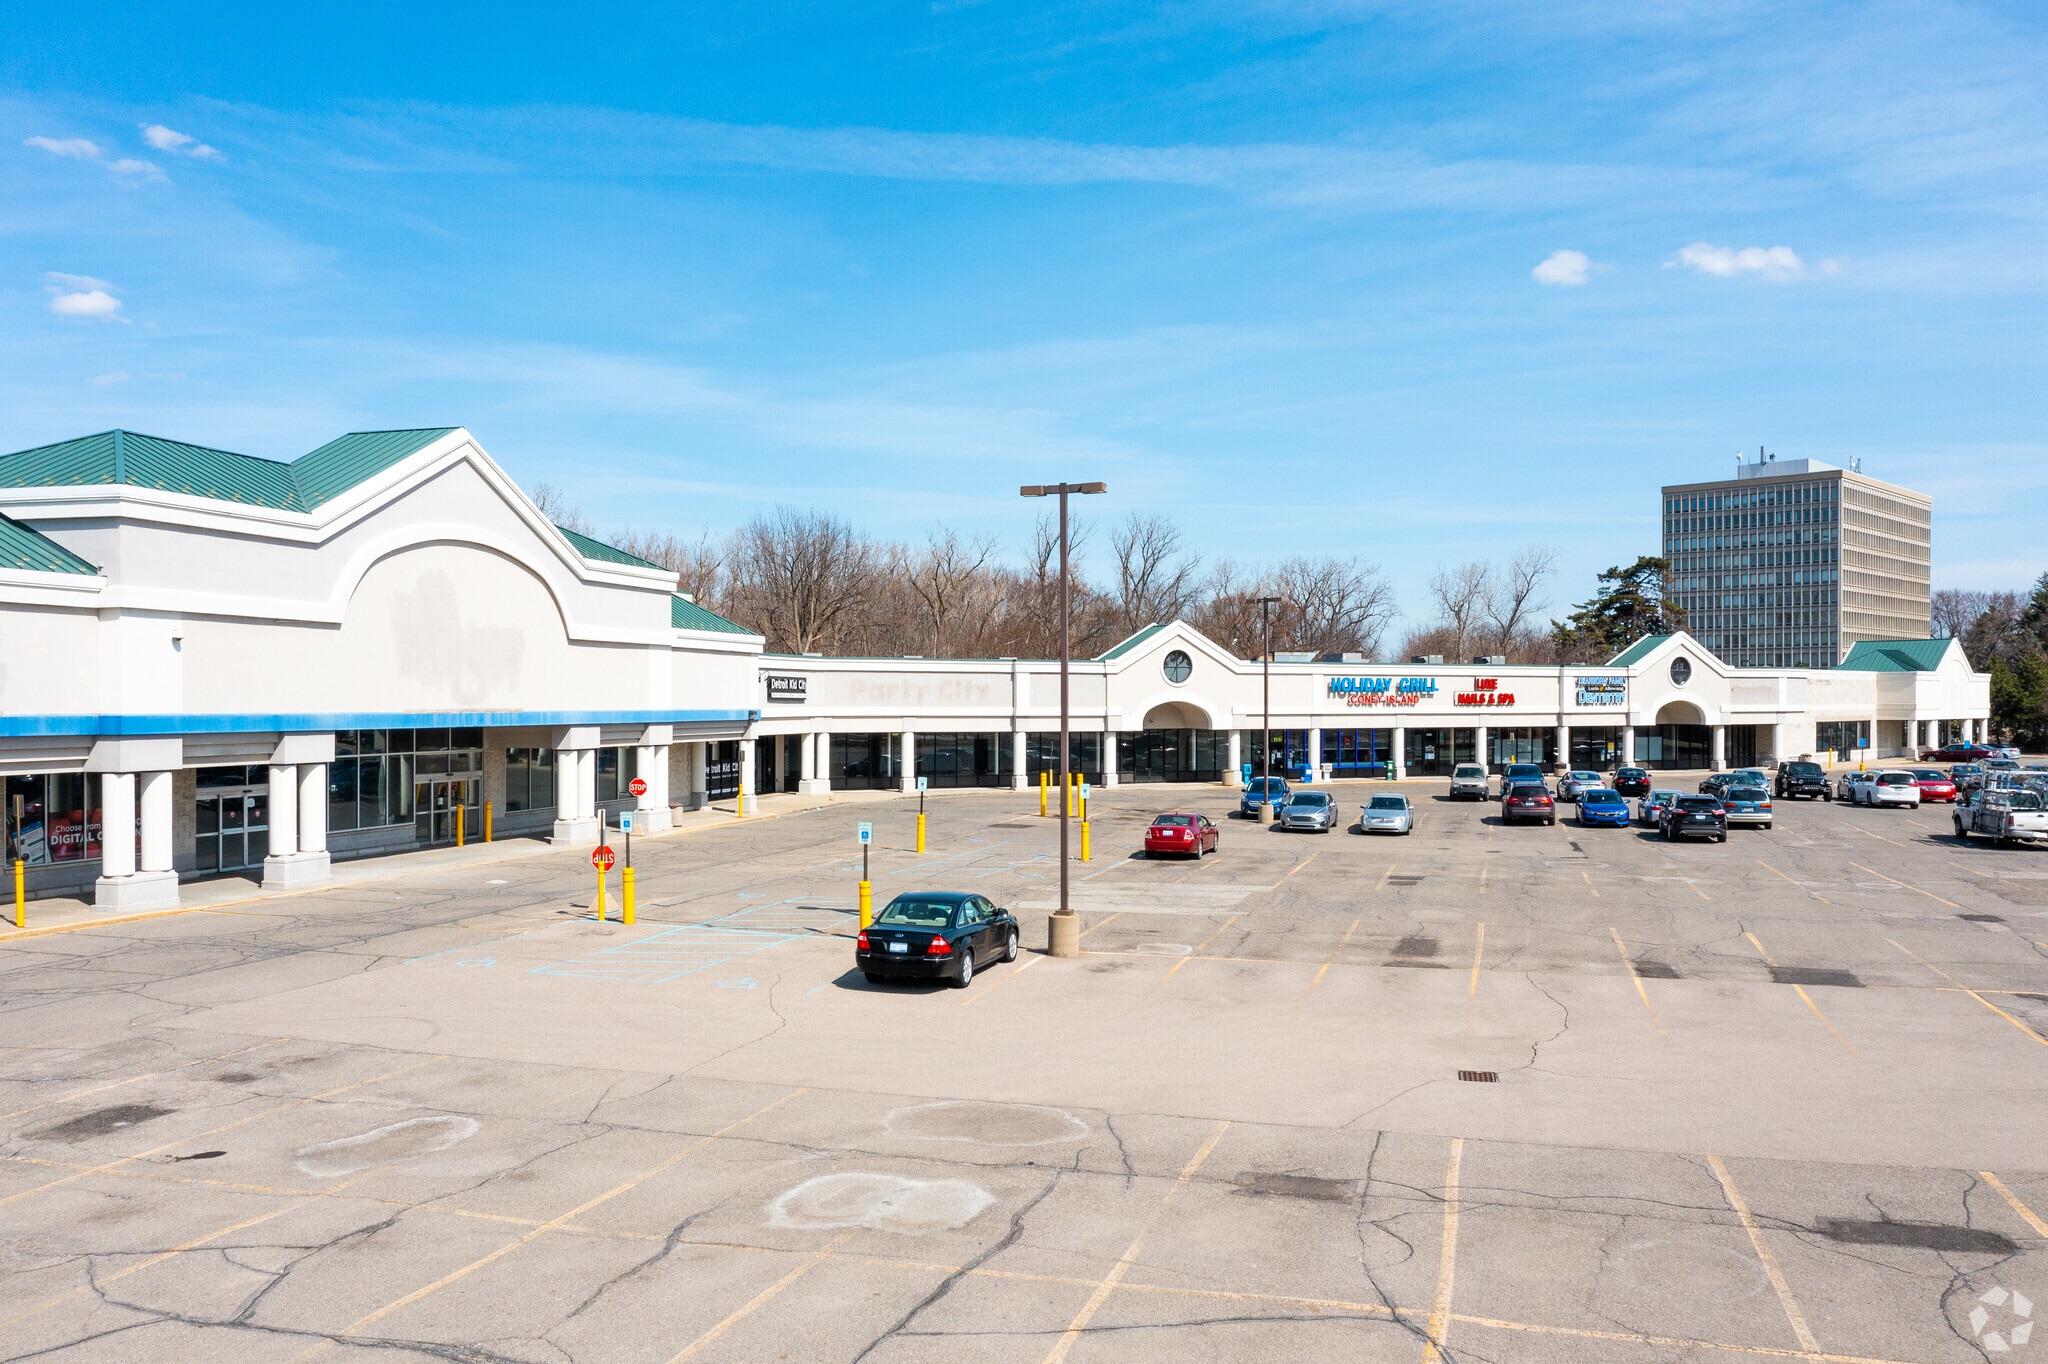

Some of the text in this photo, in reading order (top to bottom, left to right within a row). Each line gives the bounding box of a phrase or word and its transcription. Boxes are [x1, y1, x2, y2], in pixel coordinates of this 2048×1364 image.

[771, 678, 788, 690] Detroit
[789, 679, 797, 690] Kid
[1331, 677, 1439, 692] HOLIDAY GRILL
[1350, 695, 1420, 704] CONEY ISLAND
[1457, 693, 1515, 705] NAILS & SPA
[722, 763, 731, 773] Kid
[55, 825, 82, 833] Choose
